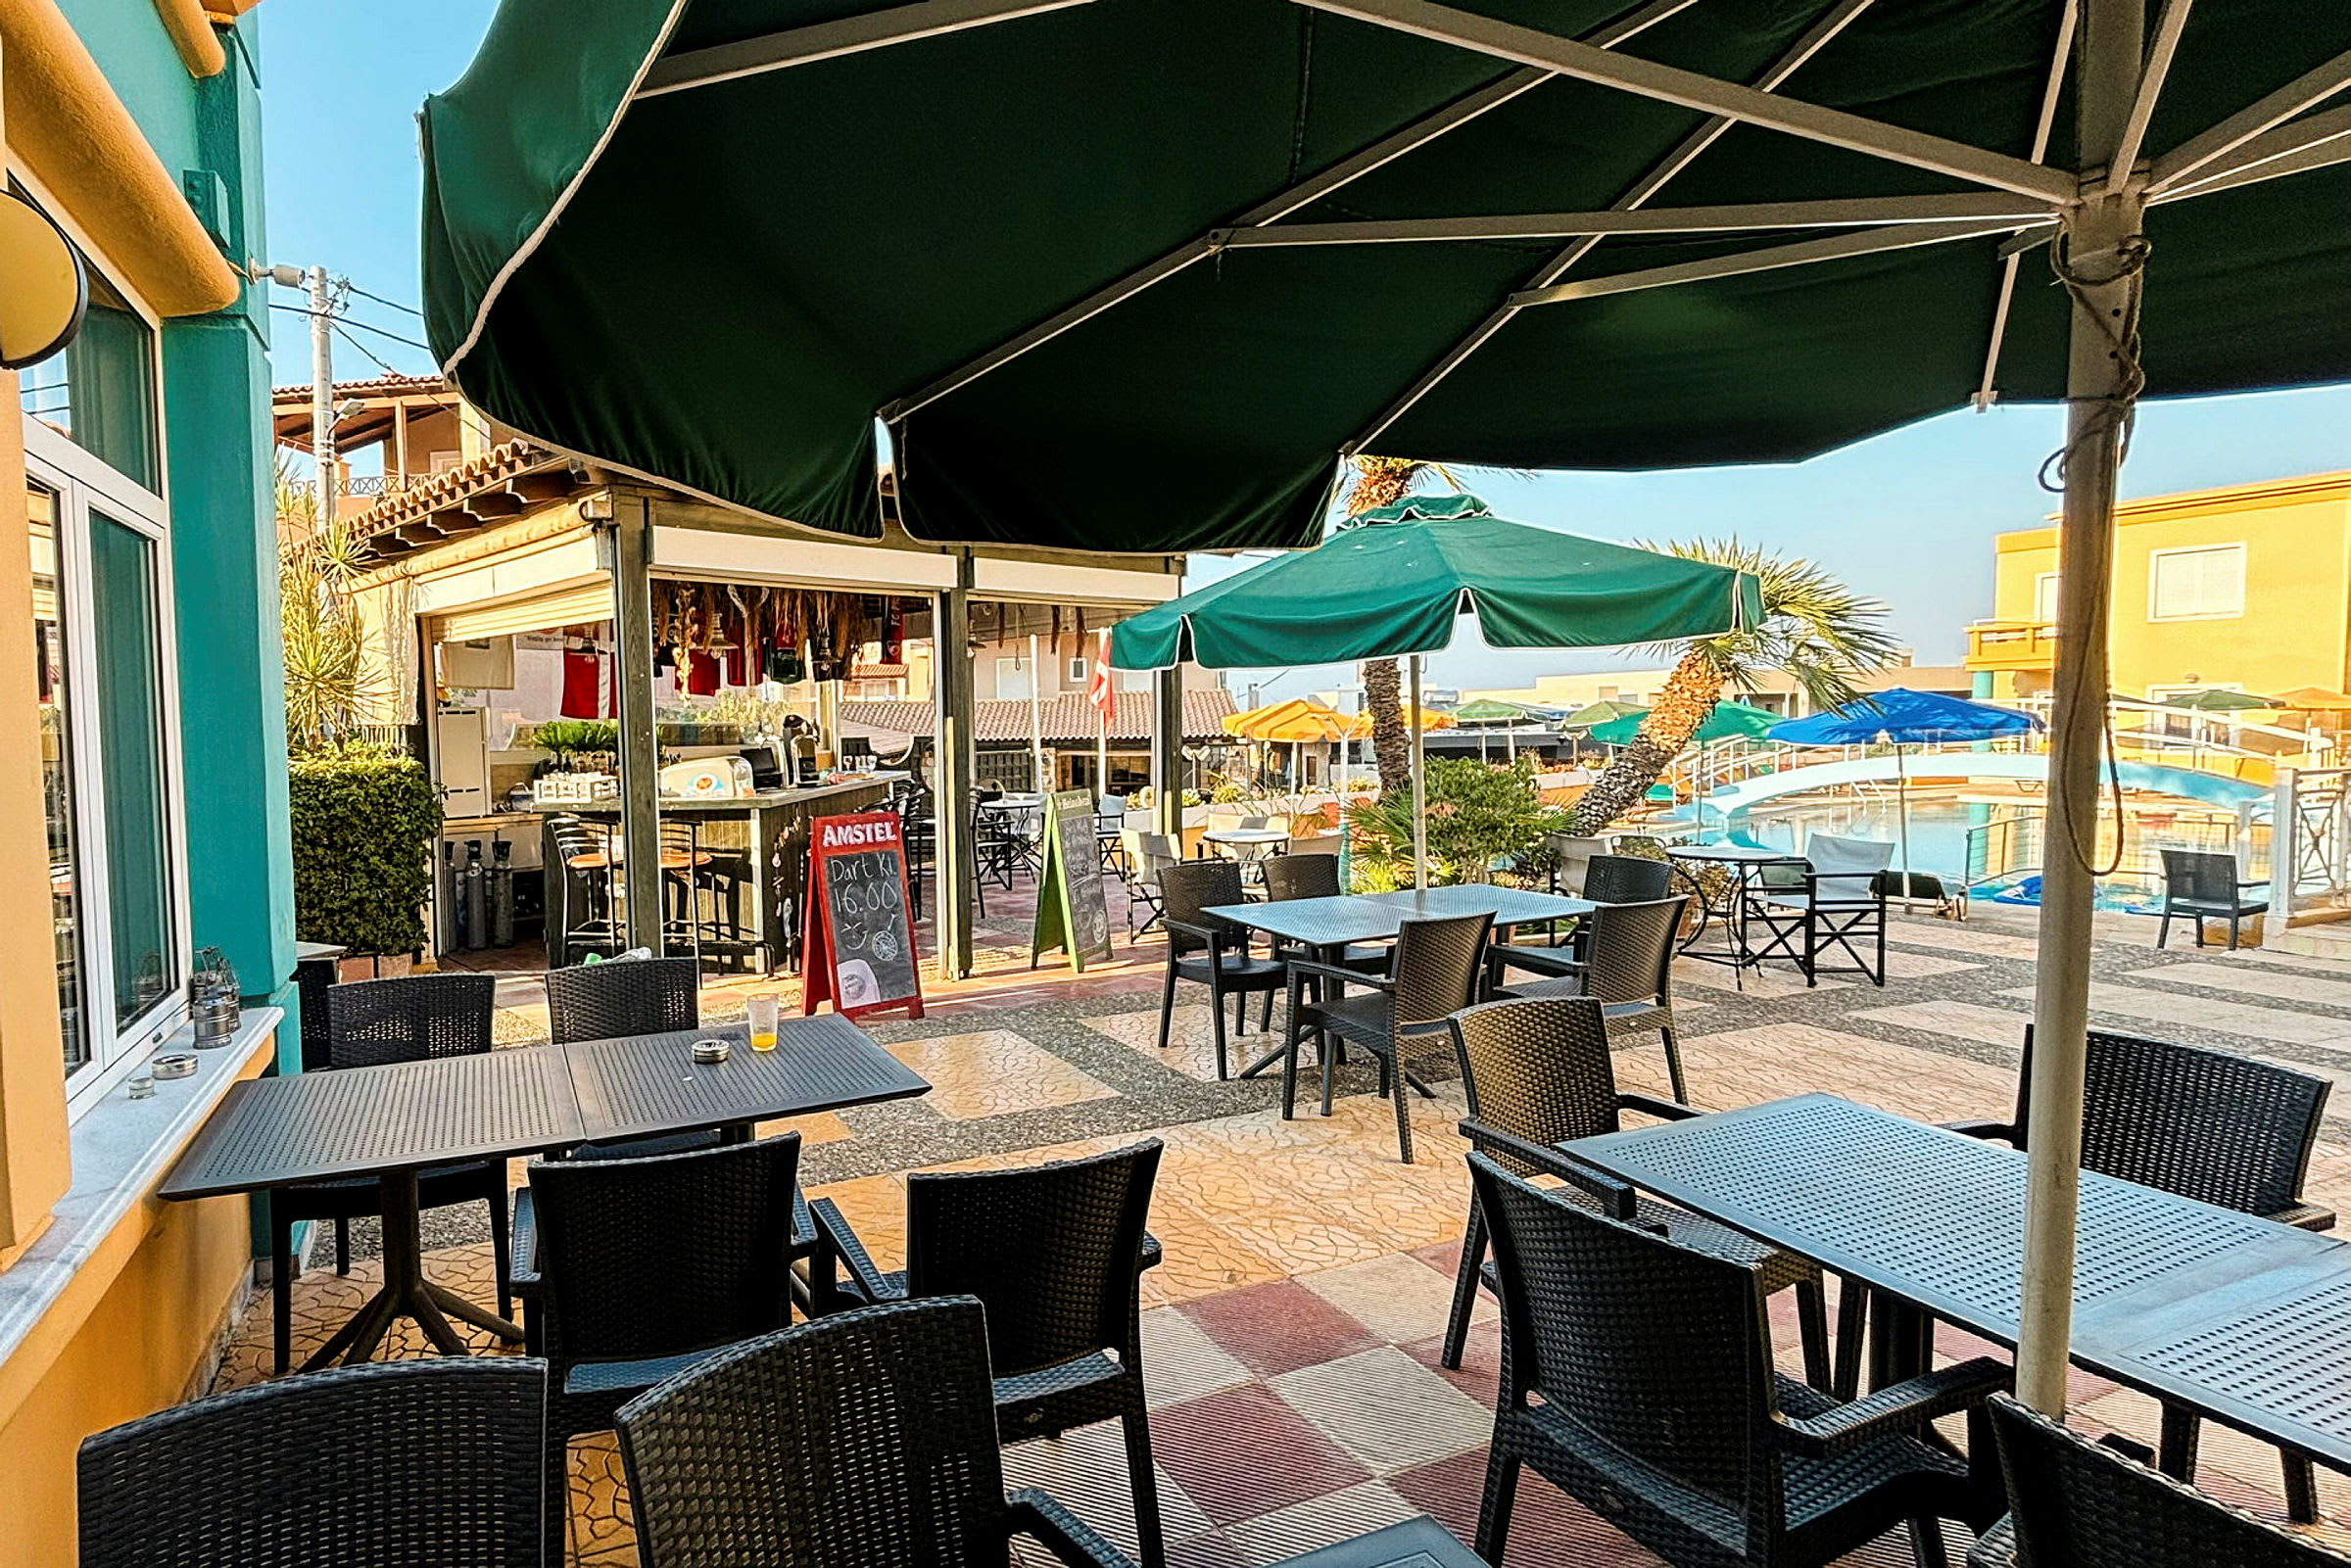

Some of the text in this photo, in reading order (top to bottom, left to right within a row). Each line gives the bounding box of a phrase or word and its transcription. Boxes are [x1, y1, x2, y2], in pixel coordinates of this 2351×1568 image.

[823, 822, 897, 847] AMSTEL
[830, 854, 874, 882] Dart
[835, 880, 897, 914] 16.00
